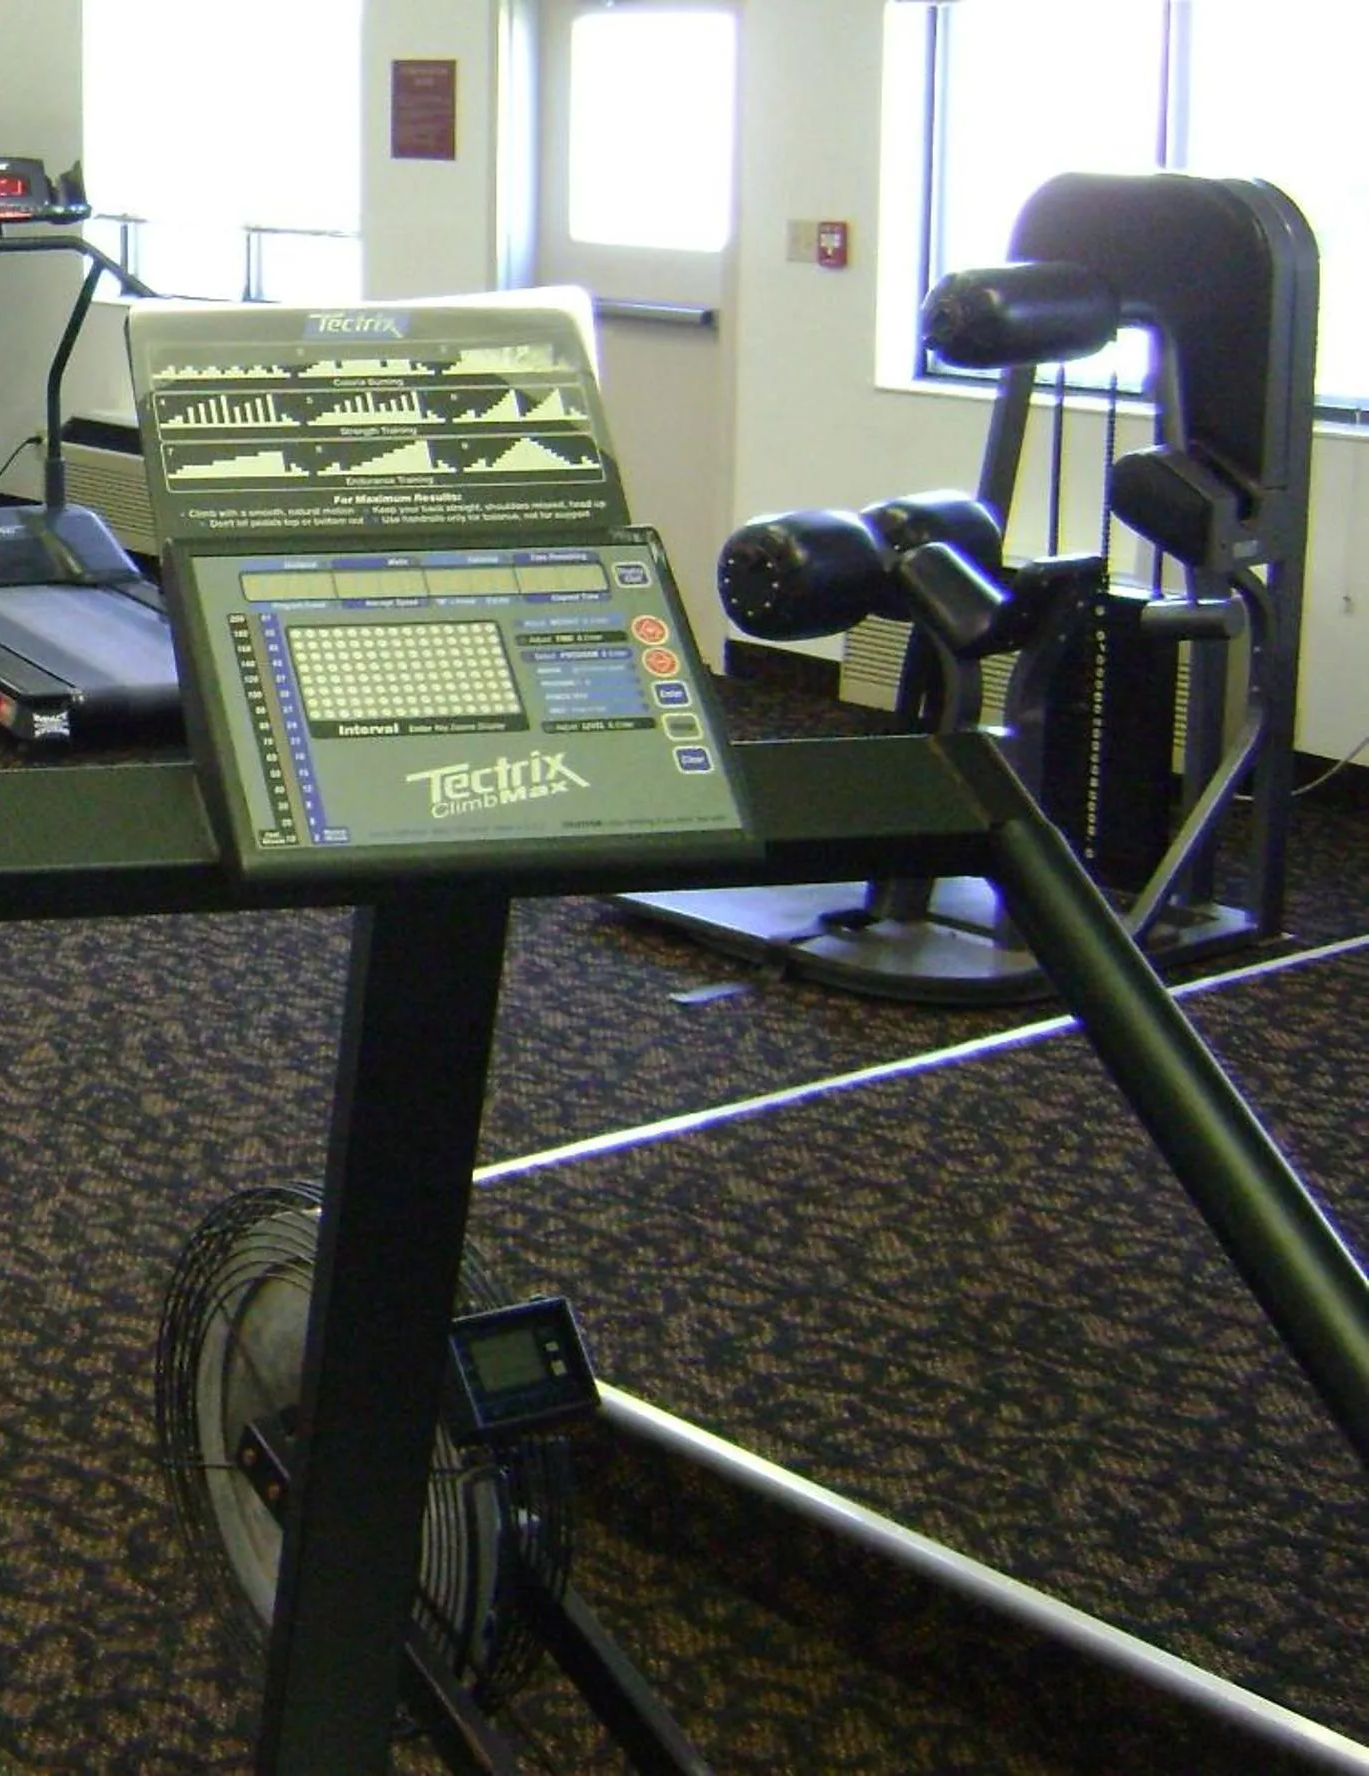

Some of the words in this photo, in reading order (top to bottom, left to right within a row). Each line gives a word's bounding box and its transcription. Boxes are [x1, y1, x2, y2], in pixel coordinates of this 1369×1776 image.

[308, 312, 404, 338] Tectrix
[380, 426, 417, 436] Training
[334, 496, 353, 504] For
[355, 494, 412, 504] Maximum
[414, 492, 462, 502] Results:
[339, 722, 399, 736] Interval
[406, 750, 591, 804] Tectrix
